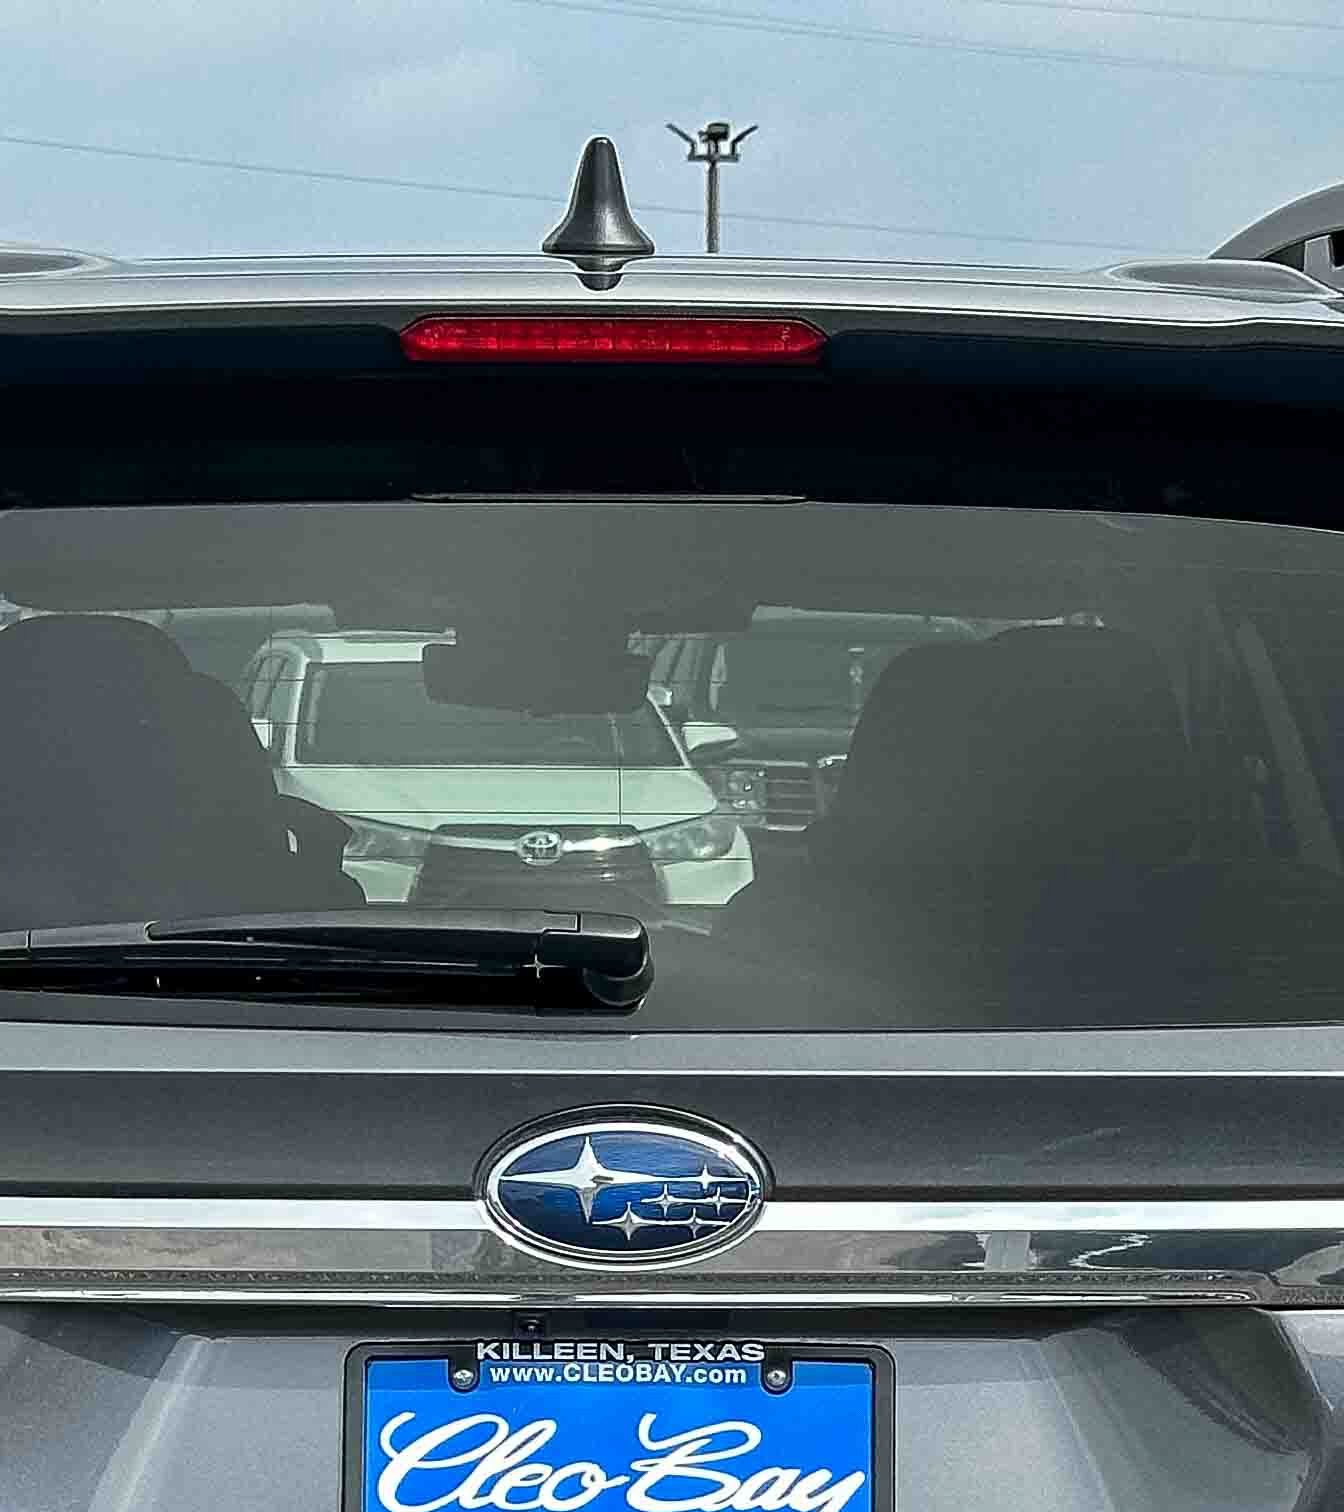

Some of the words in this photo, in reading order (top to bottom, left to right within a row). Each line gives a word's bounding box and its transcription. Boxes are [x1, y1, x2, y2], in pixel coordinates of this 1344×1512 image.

[476, 1342, 634, 1364] KILLEEN,
[647, 1343, 765, 1361] TEXAS
[489, 1363, 747, 1384] www.CLEOBAY.com
